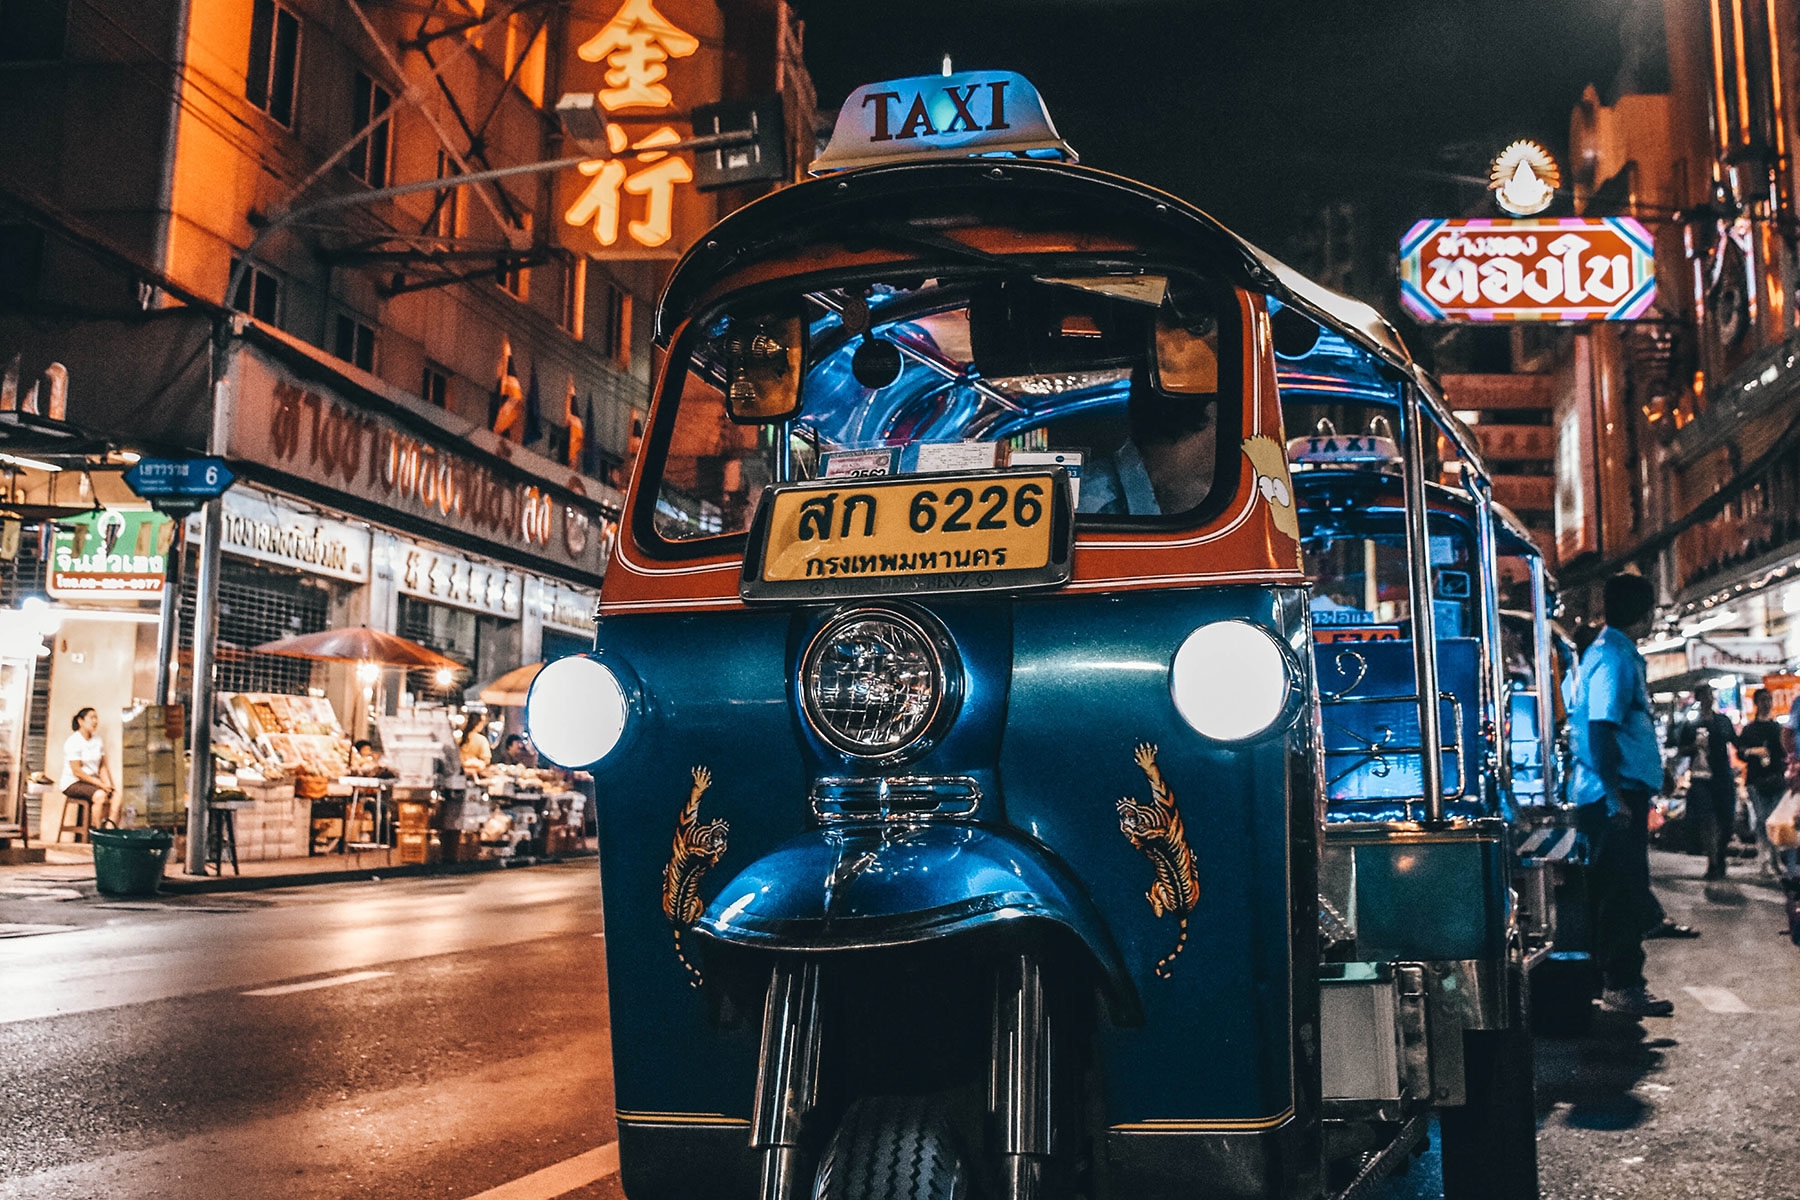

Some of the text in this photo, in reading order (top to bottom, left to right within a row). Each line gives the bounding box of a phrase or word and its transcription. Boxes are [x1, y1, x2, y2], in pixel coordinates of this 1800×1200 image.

[565, 0, 698, 246] 金行
[862, 81, 1010, 142] TAXI
[1425, 233, 1629, 304] ทองใบ
[1306, 437, 1377, 453] TAXI
[205, 465, 218, 485] 6
[798, 483, 1044, 541] สก 6226
[806, 547, 1007, 577] กรงเทพมหานคร
